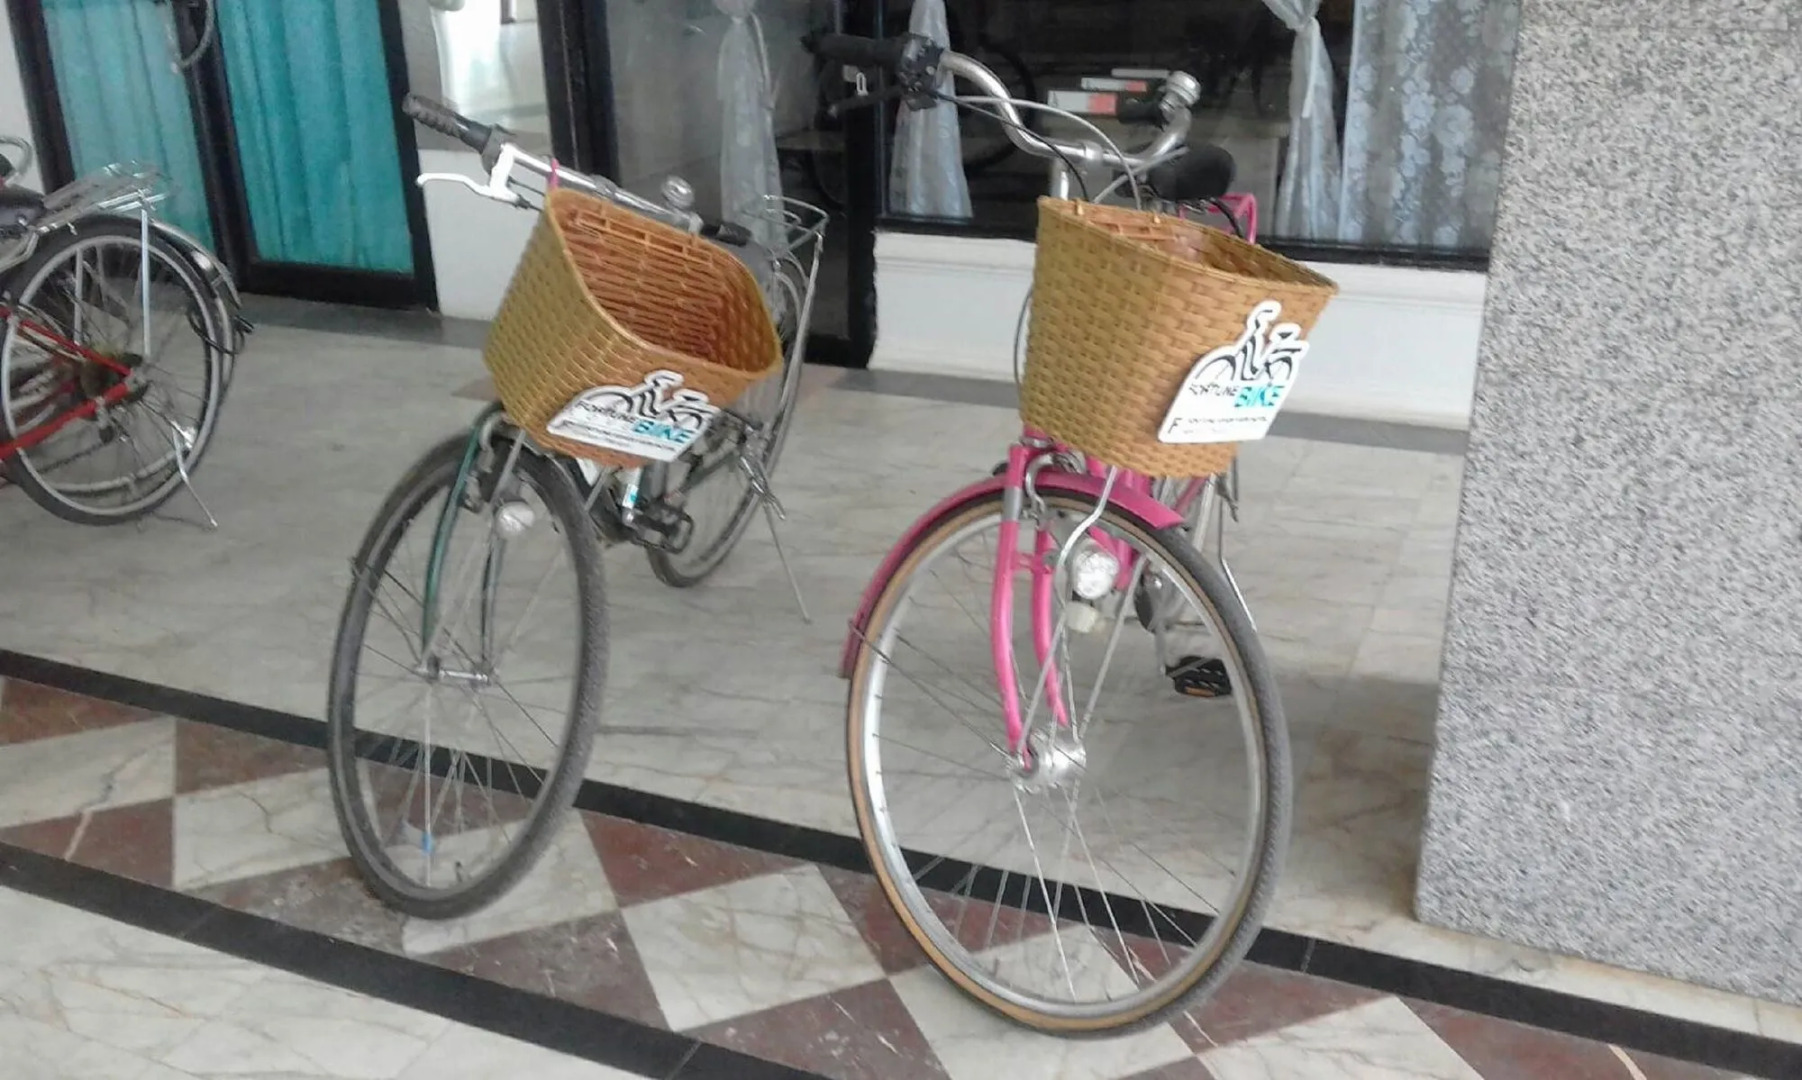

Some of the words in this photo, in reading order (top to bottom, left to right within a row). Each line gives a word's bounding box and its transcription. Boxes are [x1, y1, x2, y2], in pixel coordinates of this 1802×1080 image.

[1189, 382, 1238, 397] FORTUNE
[1234, 385, 1285, 407] BIKE
[577, 400, 638, 424] FORTUNE
[634, 420, 695, 444] BIKE
